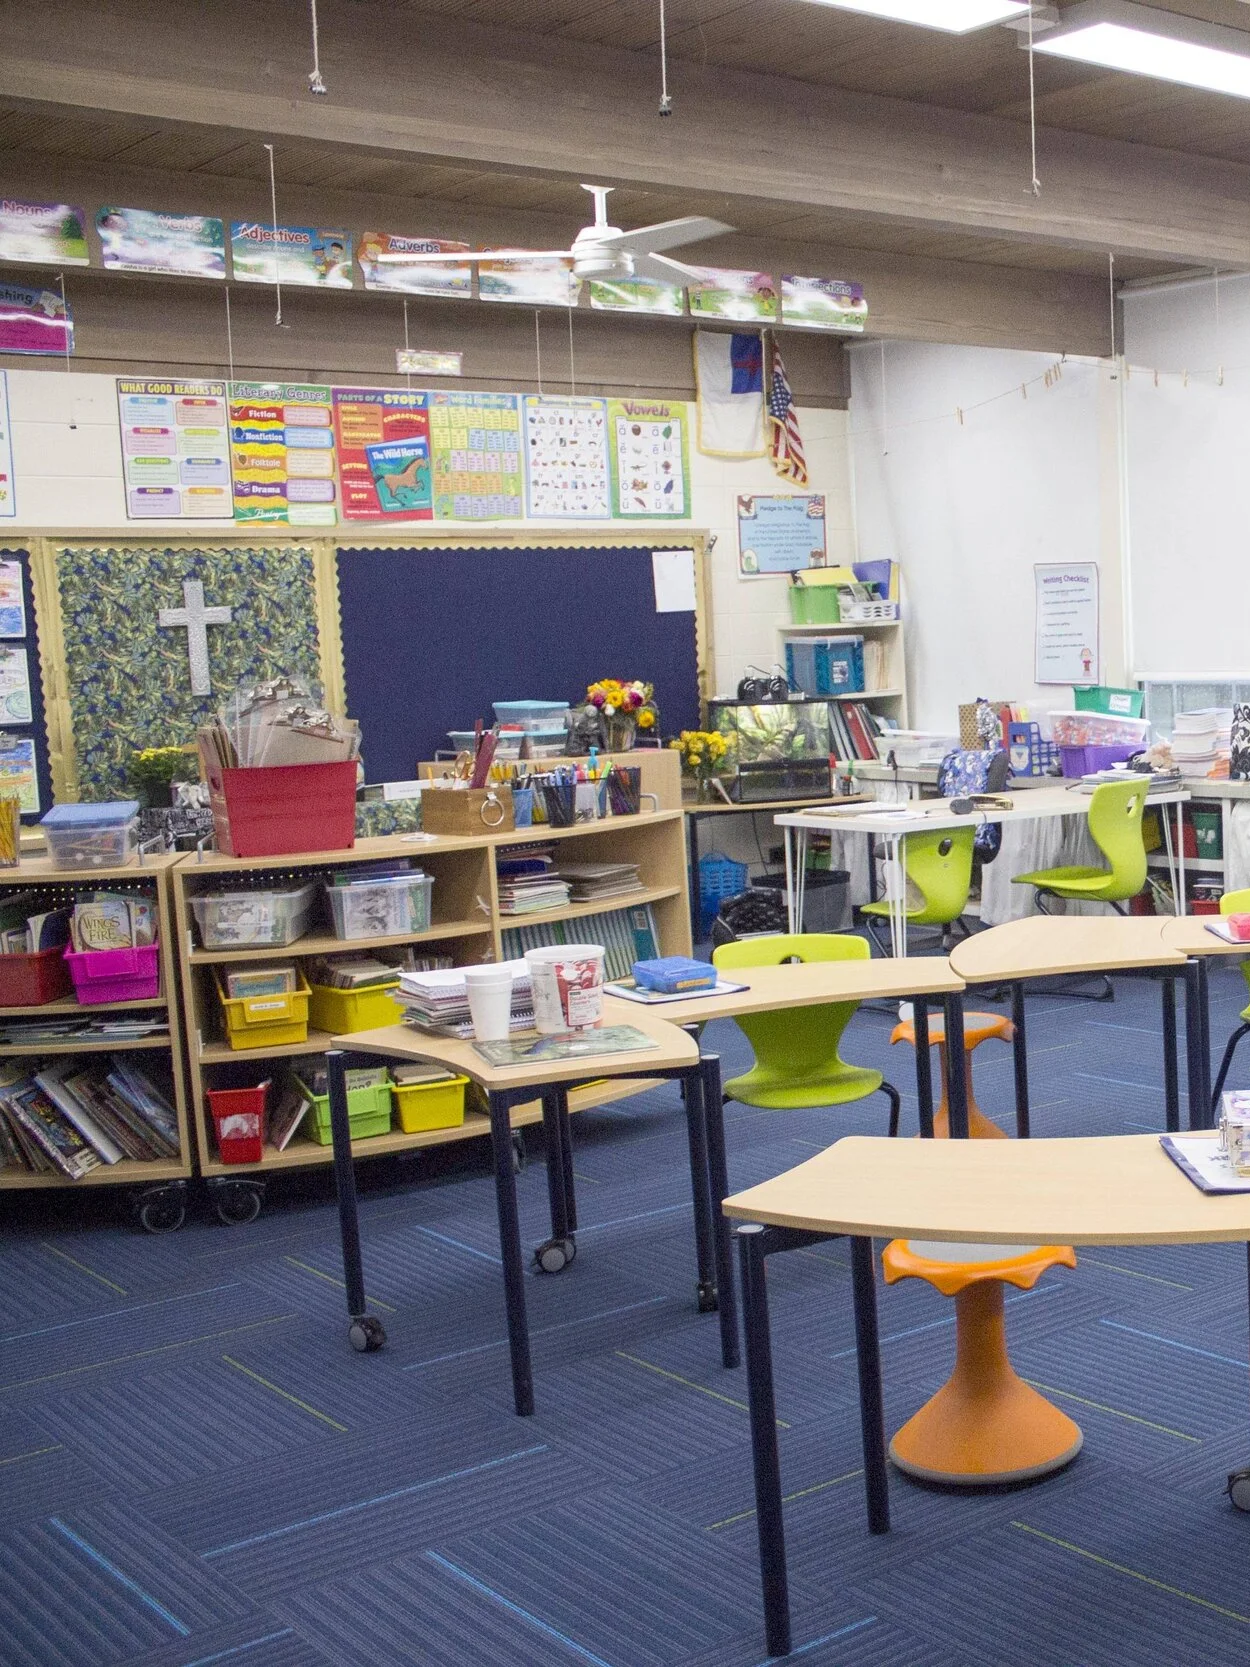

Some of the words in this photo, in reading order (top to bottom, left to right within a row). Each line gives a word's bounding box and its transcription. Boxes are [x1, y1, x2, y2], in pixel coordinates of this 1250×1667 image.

[3, 200, 51, 218] Nouns
[158, 215, 204, 233] Verbs
[239, 225, 311, 244] Adjectives
[389, 236, 440, 253] Adverbs
[121, 382, 146, 393] WHAT
[147, 383, 173, 394] GOOD
[174, 384, 209, 395] READERS
[210, 385, 223, 395] DO
[232, 384, 283, 400] Literary
[286, 386, 327, 400] Genres
[383, 393, 425, 405] STORY
[248, 410, 277, 418] Fiction
[621, 402, 671, 417] Vowels
[245, 432, 283, 441] Nonfiction
[372, 452, 384, 460] The
[383, 448, 401, 459] Wild
[401, 448, 423, 457] Horse
[251, 459, 281, 467] Folktale
[251, 485, 280, 494] Drama
[1043, 576, 1062, 584] Writing
[1063, 575, 1089, 583] Checklist
[82, 915, 120, 929] WINGS
[89, 928, 117, 941] FIRE
